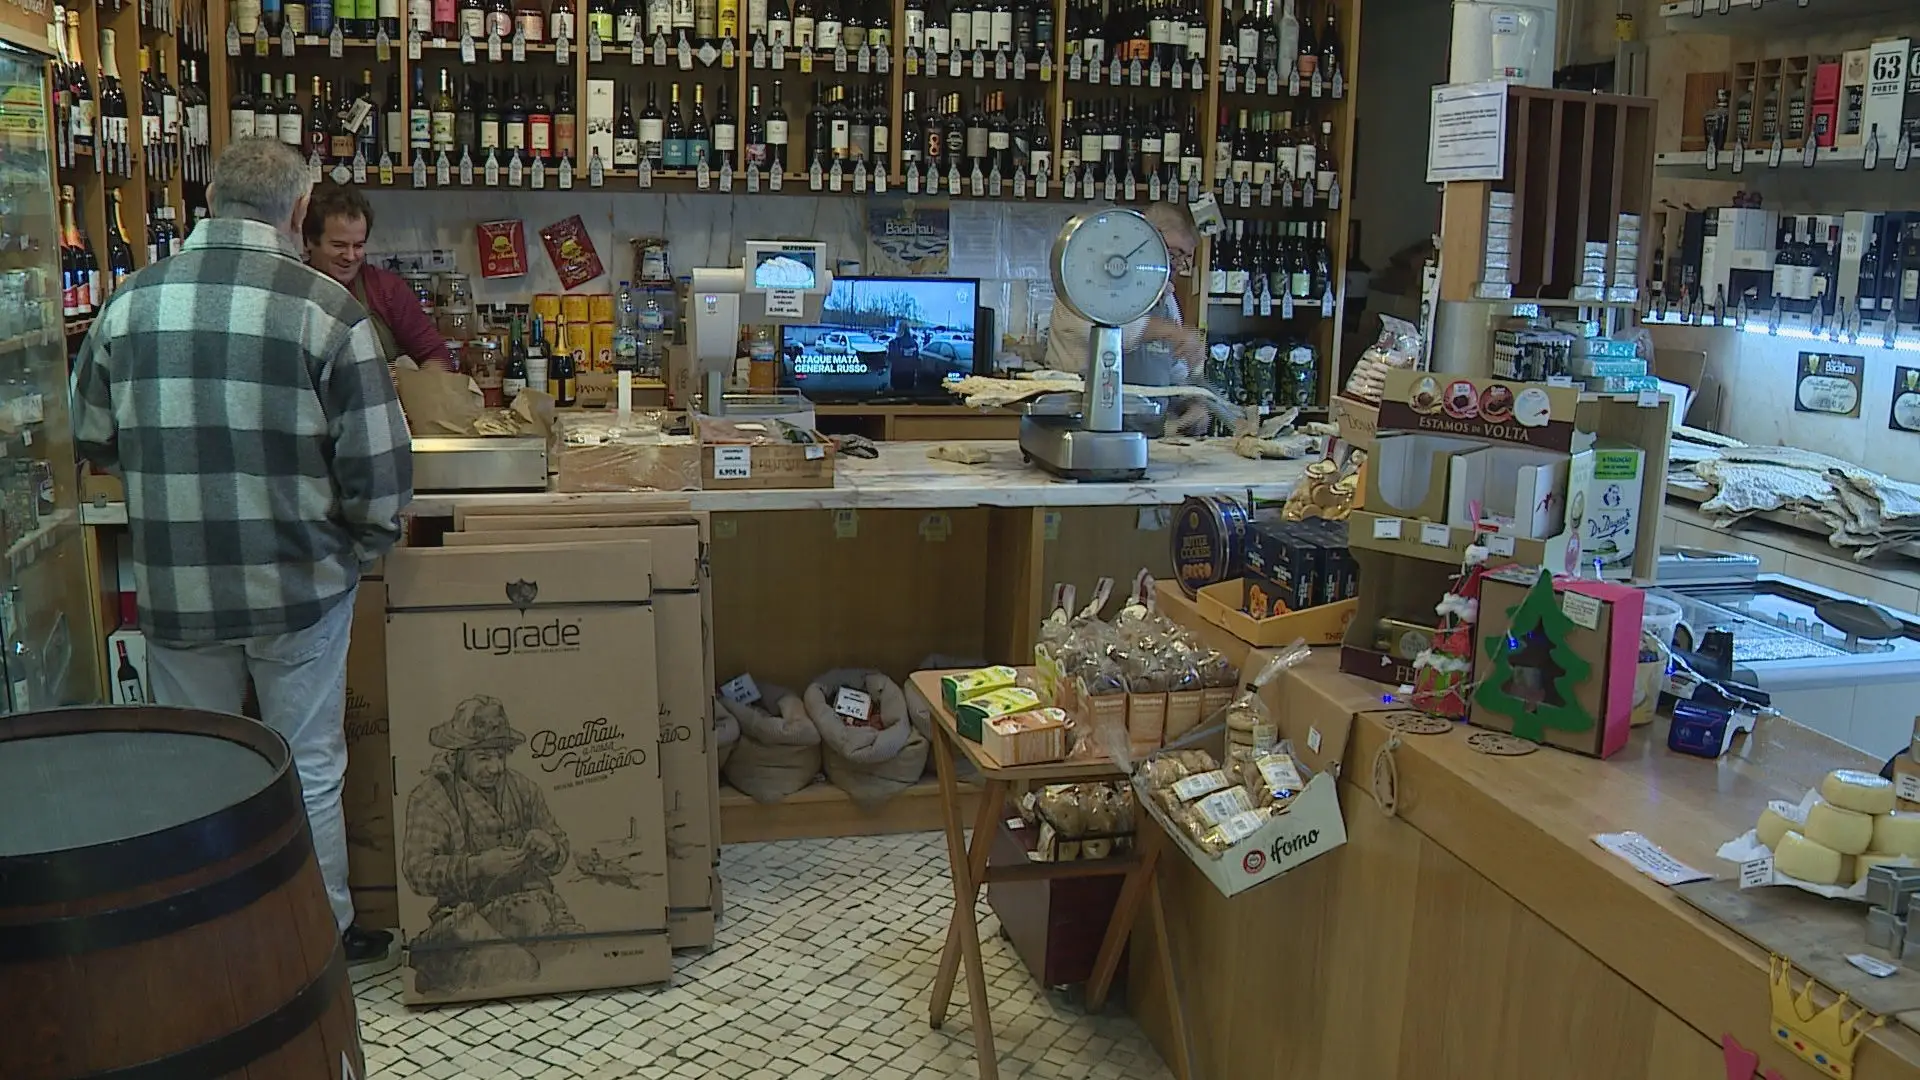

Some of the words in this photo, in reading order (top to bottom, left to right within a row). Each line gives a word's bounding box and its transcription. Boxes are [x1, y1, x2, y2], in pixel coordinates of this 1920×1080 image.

[1873, 55, 1902, 81] 63
[1872, 84, 1899, 93] PORTO
[885, 221, 934, 235] Bacalhau
[794, 355, 833, 364] ATAQUE
[833, 355, 859, 364] MATA
[794, 364, 836, 373] GENERAL
[837, 364, 868, 373] RUSSO
[1419, 416, 1469, 433] ESTAMOS
[1484, 423, 1529, 441] VOLTA
[463, 618, 580, 656] lugrade
[530, 718, 625, 759] Bacalhau,
[541, 749, 646, 778] tradição
